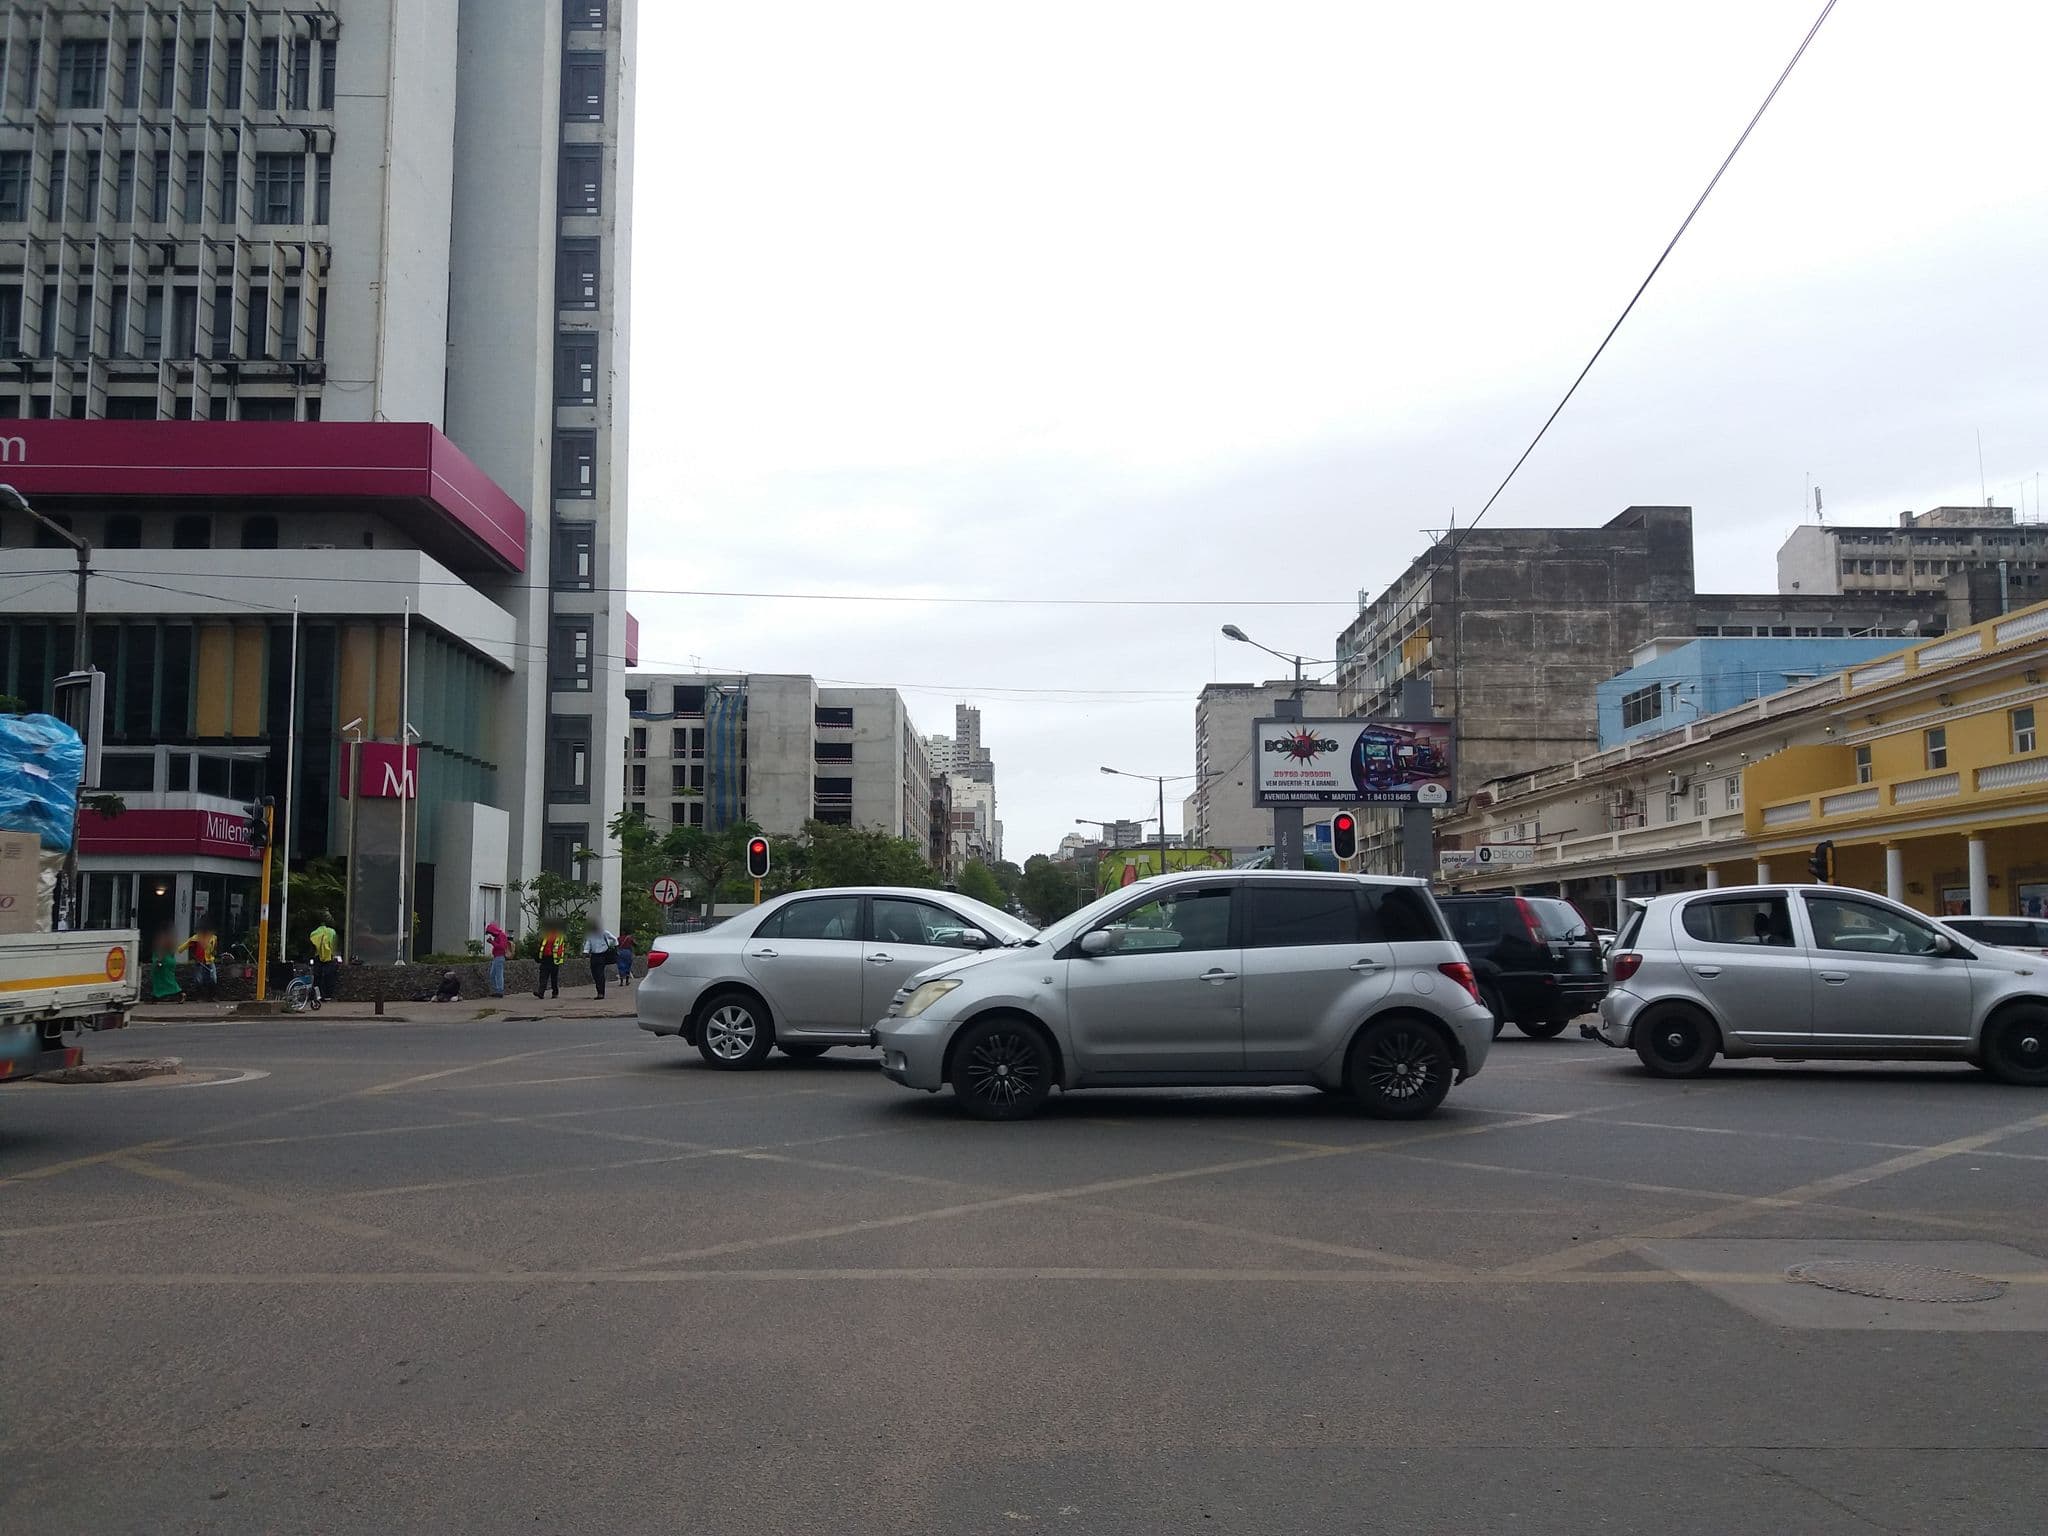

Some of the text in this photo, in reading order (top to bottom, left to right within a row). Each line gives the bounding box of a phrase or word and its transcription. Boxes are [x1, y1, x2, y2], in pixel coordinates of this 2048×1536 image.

[1264, 793, 1290, 801] AVENIDA
[1291, 793, 1320, 801] MARGINAL
[1331, 793, 1356, 801] MAPUTO
[1493, 849, 1532, 860] DEKOR
